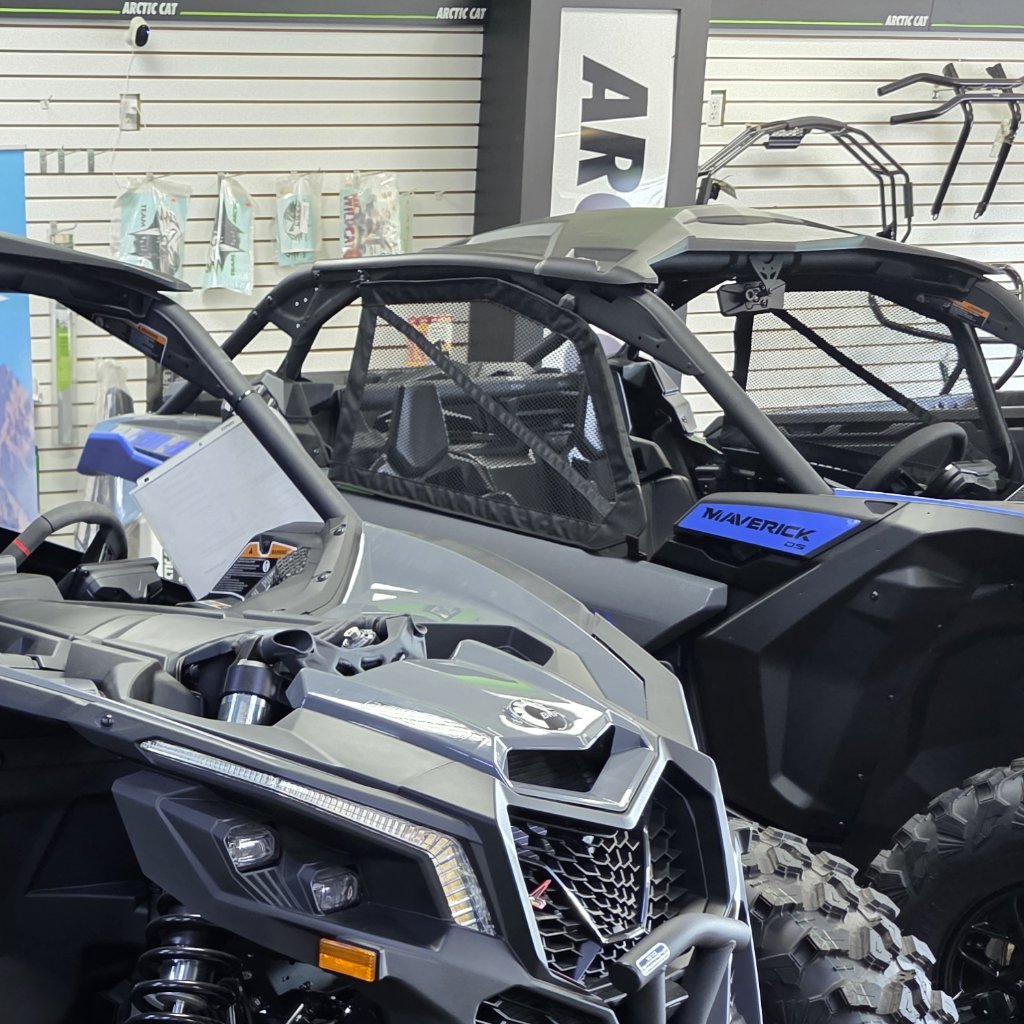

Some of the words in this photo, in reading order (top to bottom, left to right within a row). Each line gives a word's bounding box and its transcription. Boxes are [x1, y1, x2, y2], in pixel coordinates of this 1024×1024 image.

[122, 2, 158, 15] ARCTIC
[159, 3, 179, 15] CAT
[437, 7, 469, 20] ARCTIC
[469, 8, 487, 20] CAT
[885, 15, 914, 26] ARCTIC
[913, 16, 929, 27] CAT
[701, 507, 817, 543] MAVERICK
[783, 541, 808, 551] DS
